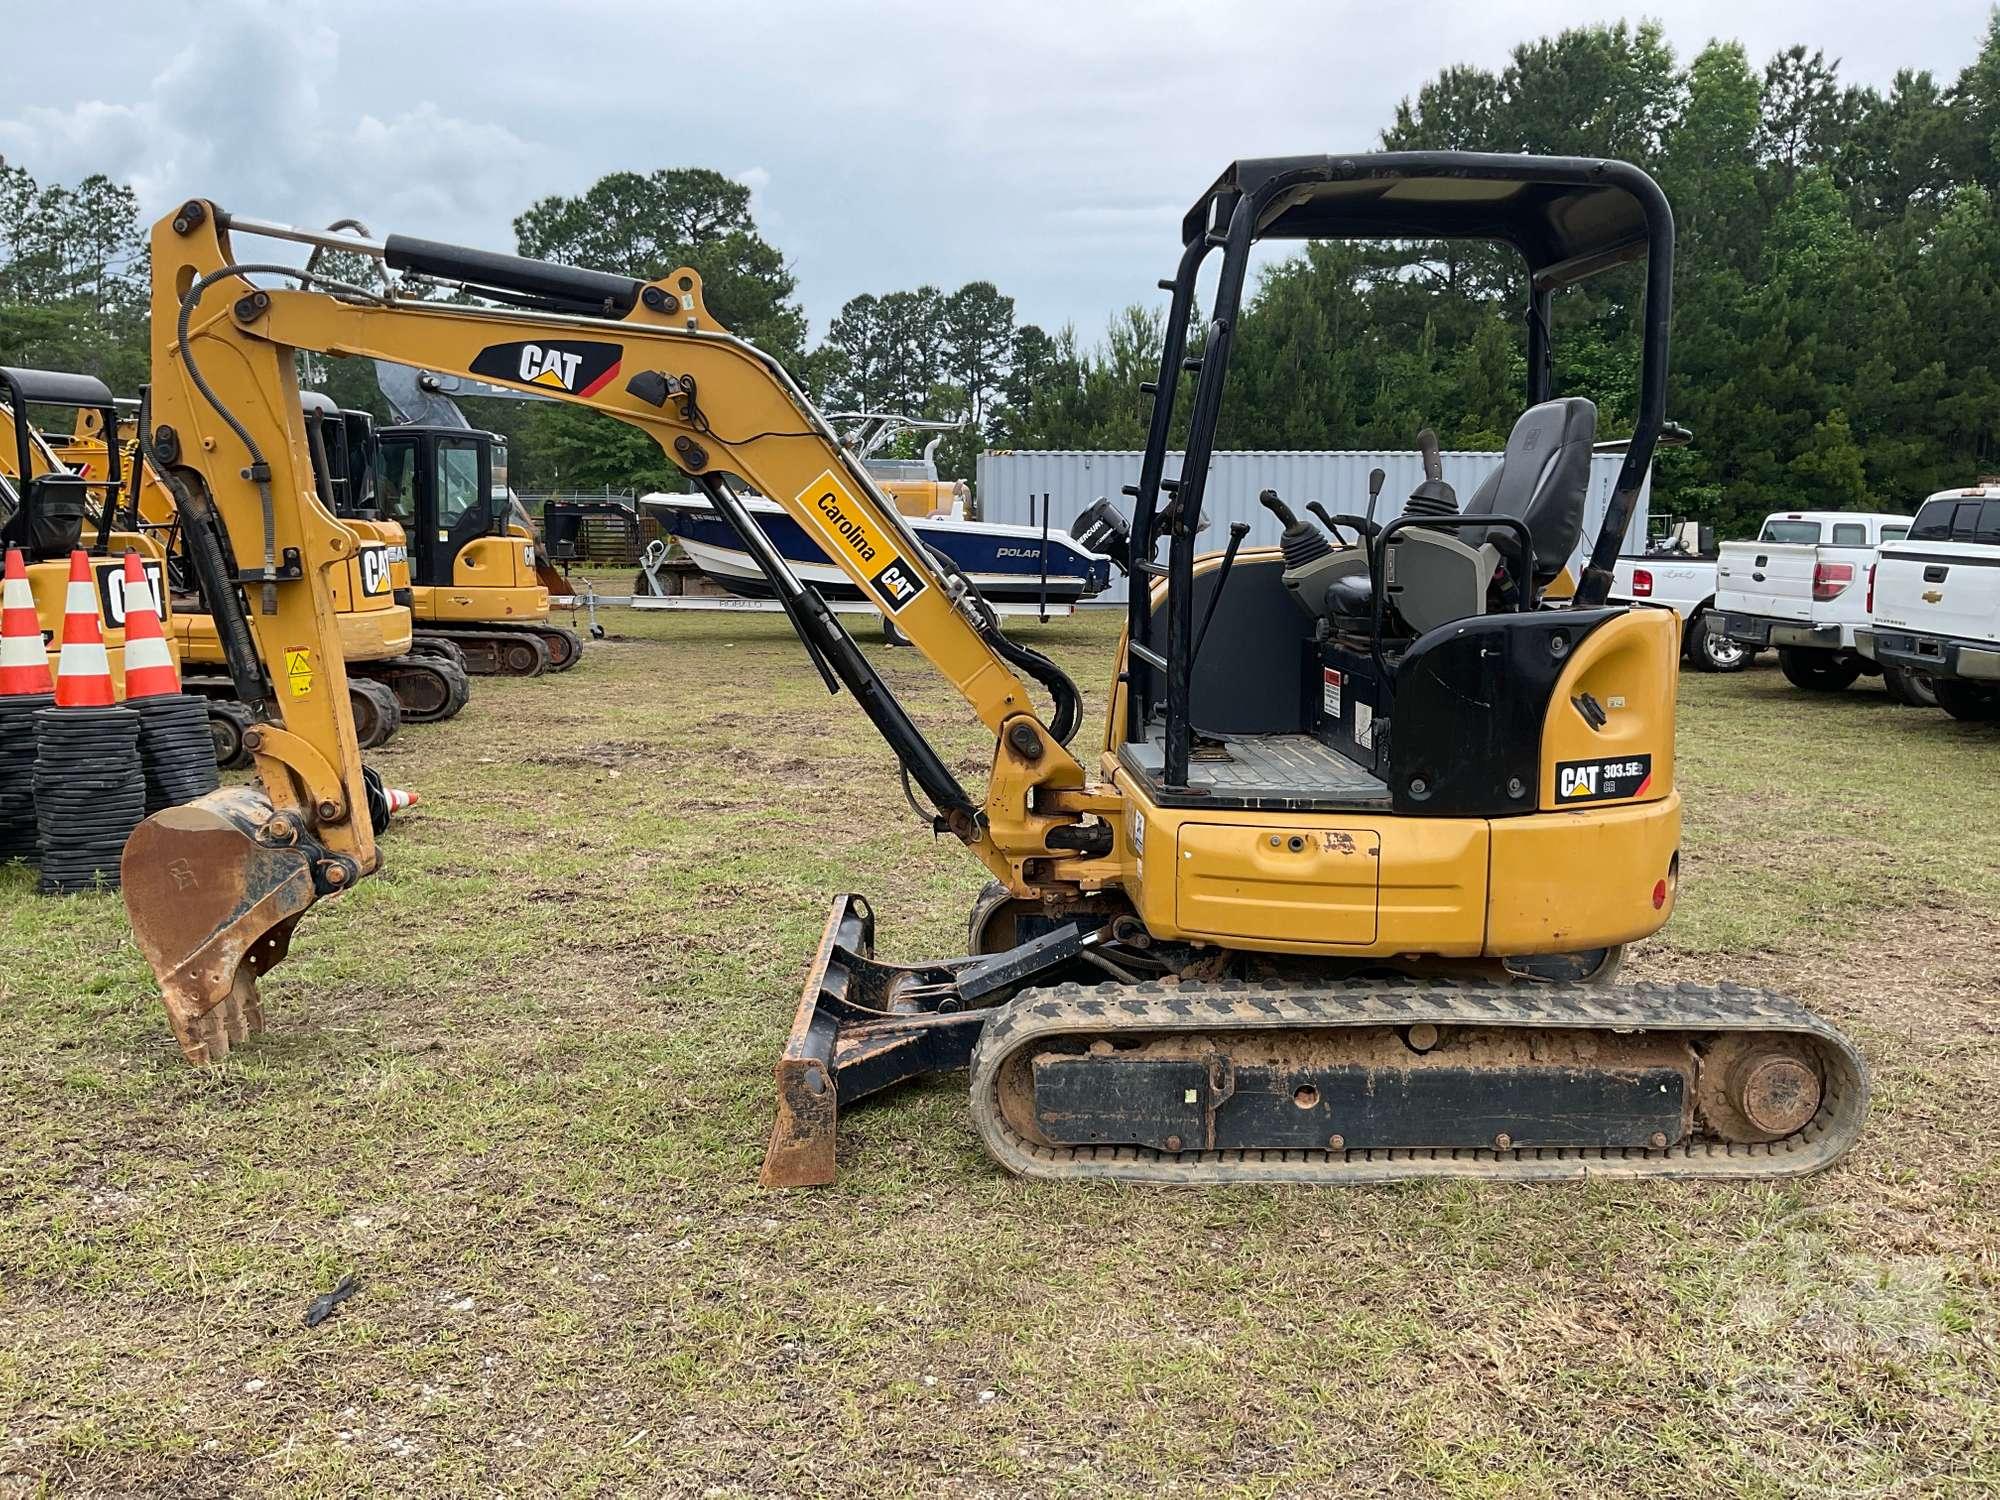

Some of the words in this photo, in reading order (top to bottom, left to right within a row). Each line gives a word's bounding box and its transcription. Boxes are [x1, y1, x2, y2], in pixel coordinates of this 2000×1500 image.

[519, 344, 582, 390] CAT
[818, 492, 876, 562] Carolina
[996, 547, 1041, 558] POLAR
[108, 567, 163, 623] CT
[881, 567, 915, 601] CAT
[1561, 765, 1600, 797] CAT
